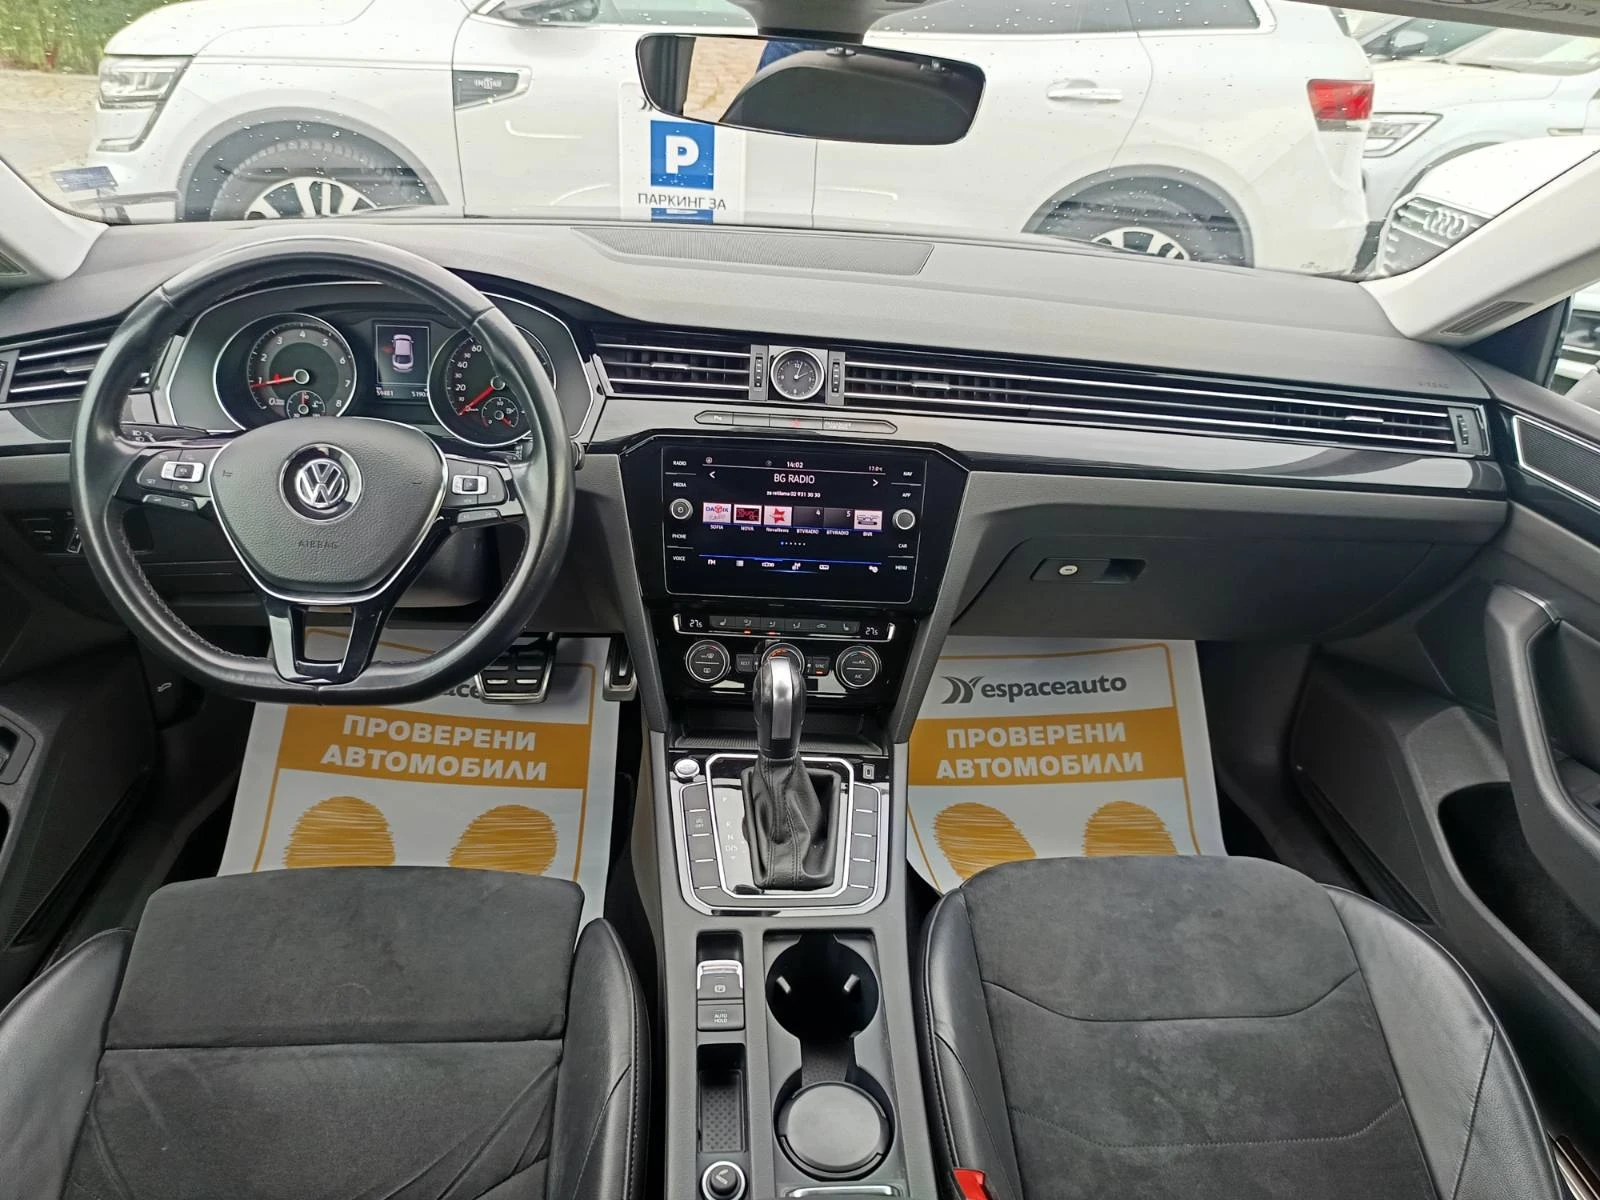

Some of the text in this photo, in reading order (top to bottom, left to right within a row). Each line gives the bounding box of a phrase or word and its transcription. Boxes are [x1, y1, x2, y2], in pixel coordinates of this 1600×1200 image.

[665, 135, 700, 174] P
[637, 192, 727, 211] ПАРКИНГ ЗА
[299, 330, 306, 339] 4
[276, 336, 284, 346] 3
[321, 338, 329, 347] 5
[471, 344, 483, 353] 60
[260, 353, 268, 362] 2
[339, 356, 346, 365] 6
[457, 361, 468, 369] 40
[344, 379, 351, 388] 7
[455, 383, 467, 391] 20
[335, 400, 343, 408] 8
[786, 461, 804, 469] 14:02
[773, 473, 815, 484] BG RADIO
[980, 674, 1127, 703] espaceauto
[342, 714, 537, 752] ПРОВЕРЕНИ
[946, 721, 1127, 749] ПРОВЕРЕНИ
[319, 743, 548, 782] АВТОМОБИЛИ
[935, 751, 1144, 780] АВТОМОБИЛИ
